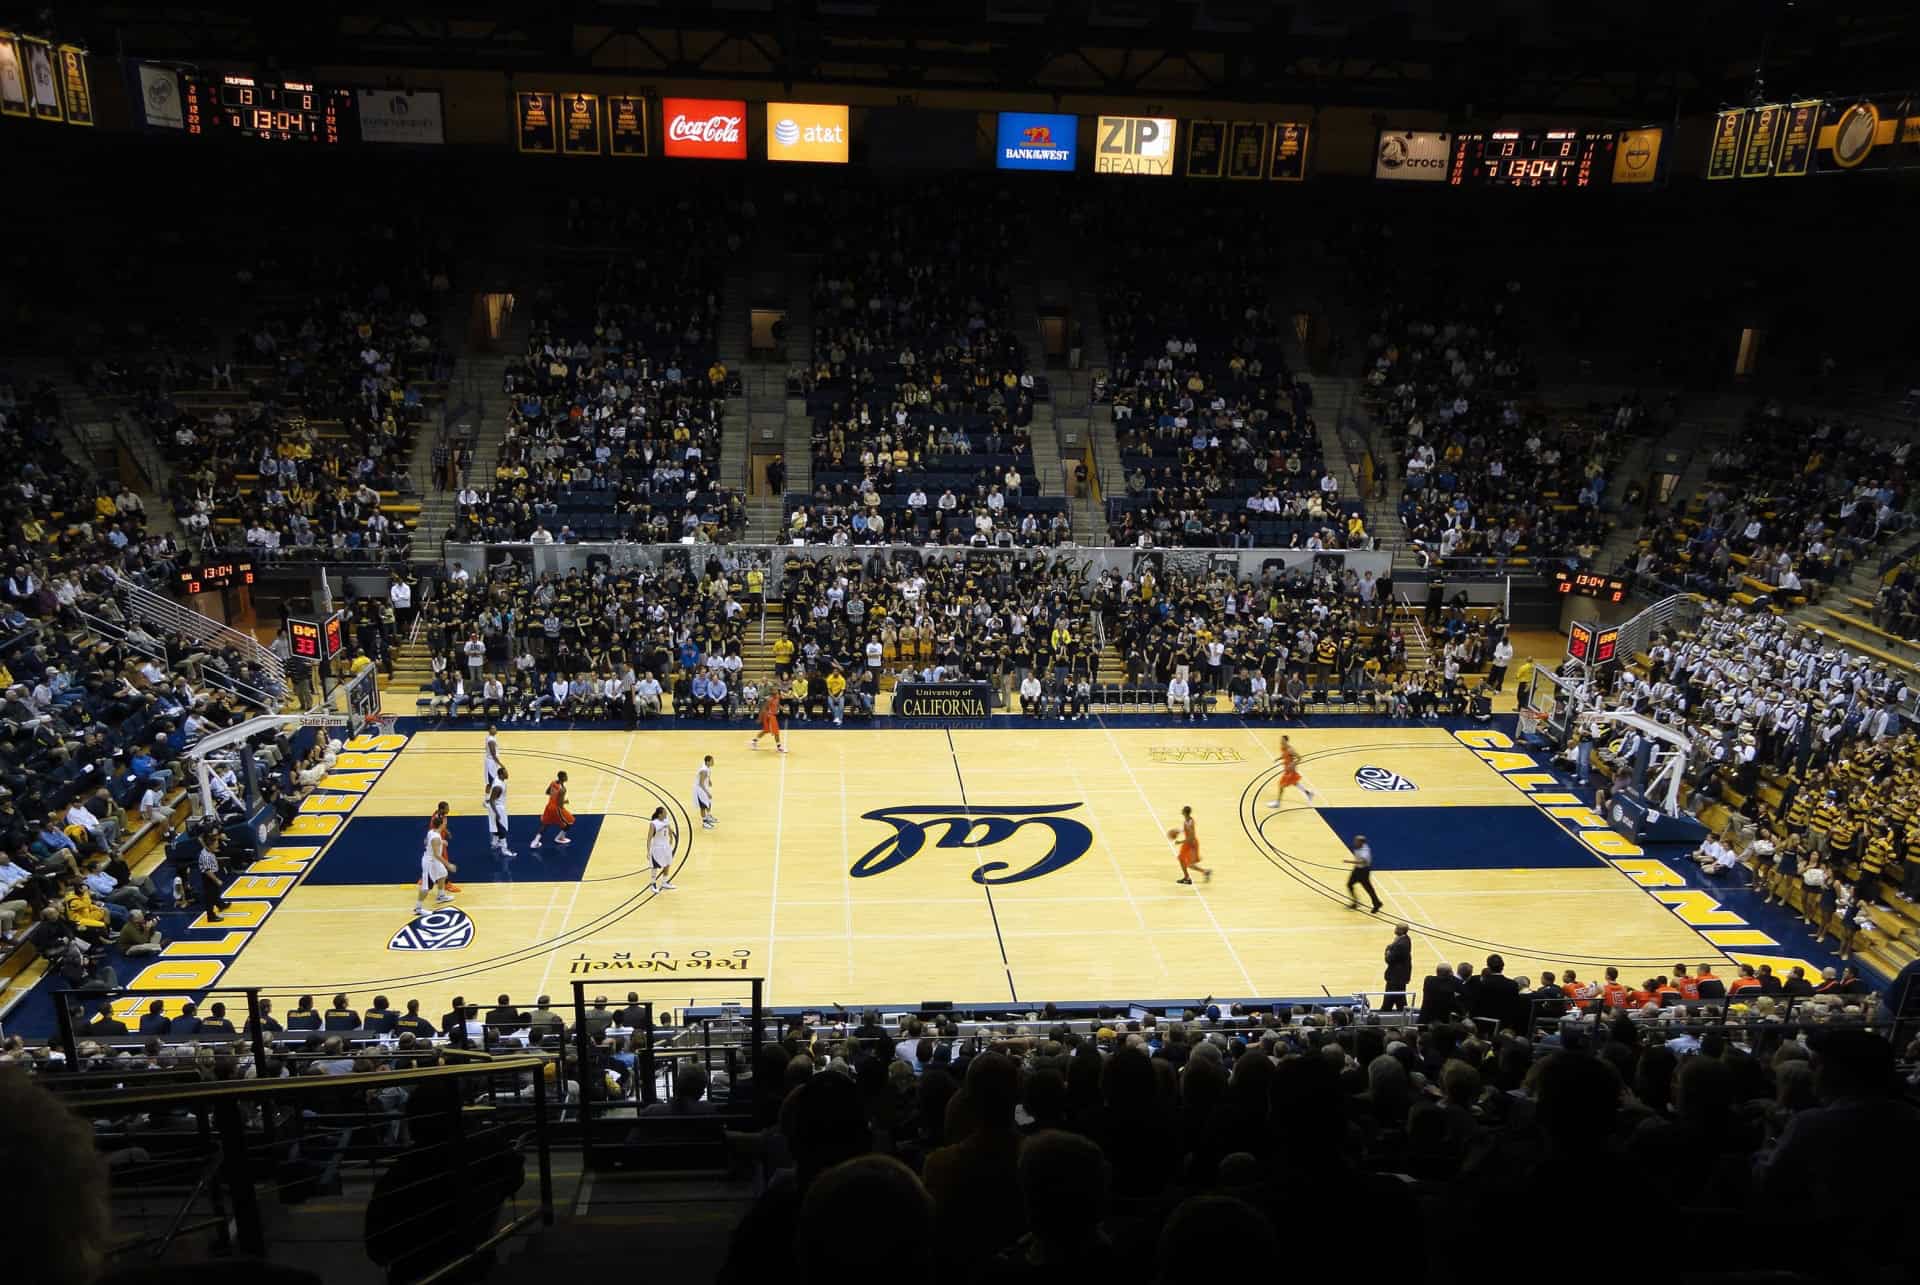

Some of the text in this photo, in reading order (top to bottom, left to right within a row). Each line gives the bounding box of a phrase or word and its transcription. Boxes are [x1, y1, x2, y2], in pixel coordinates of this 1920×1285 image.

[240, 89, 253, 105] 13
[303, 95, 312, 110] 8
[254, 110, 302, 132] 13:04
[803, 122, 843, 143] at&t
[1100, 118, 1159, 156] ZIP
[1006, 148, 1033, 159] BANK
[1043, 150, 1070, 161] WEST
[1501, 143, 1514, 156] 13
[1560, 142, 1569, 156] 8
[1098, 157, 1169, 174] REALTY
[1407, 159, 1445, 168] crocs
[1508, 160, 1557, 177] 13:04
[204, 564, 232, 580] 13:04
[246, 573, 254, 584] 8
[188, 582, 200, 593] 13
[1559, 583, 1571, 592] 13
[1576, 574, 1605, 588] 13:04
[915, 688, 973, 698] University of
[903, 699, 985, 717] CALIFORNIA
[850, 802, 1092, 885] Cal
[1452, 729, 1828, 988] CALIFORNIA
[570, 958, 749, 974] Pete Newell
